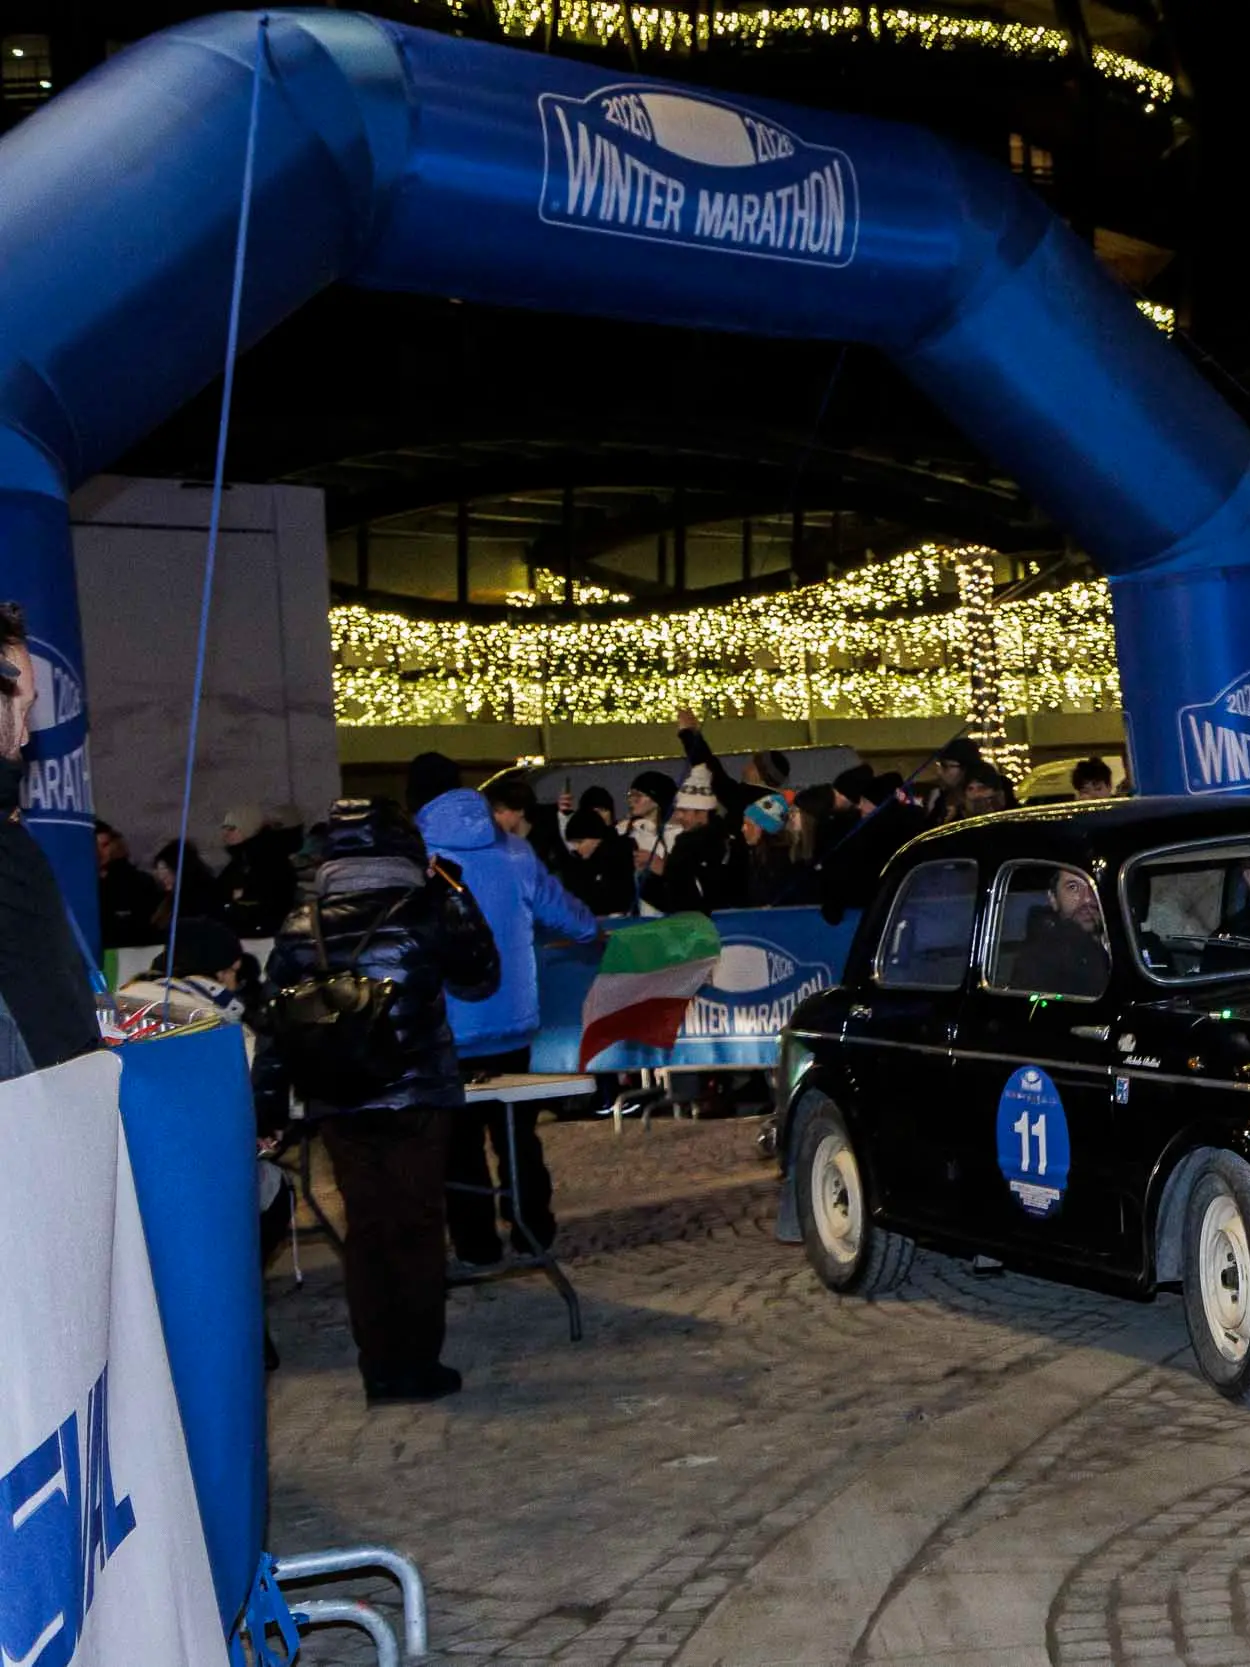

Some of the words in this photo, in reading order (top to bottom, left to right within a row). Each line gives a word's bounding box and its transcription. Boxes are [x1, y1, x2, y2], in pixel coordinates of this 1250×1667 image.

[601, 94, 652, 141] 2026
[555, 105, 685, 233] WINTER
[694, 159, 847, 256] MARATHON
[1014, 1110, 1048, 1176] 11
